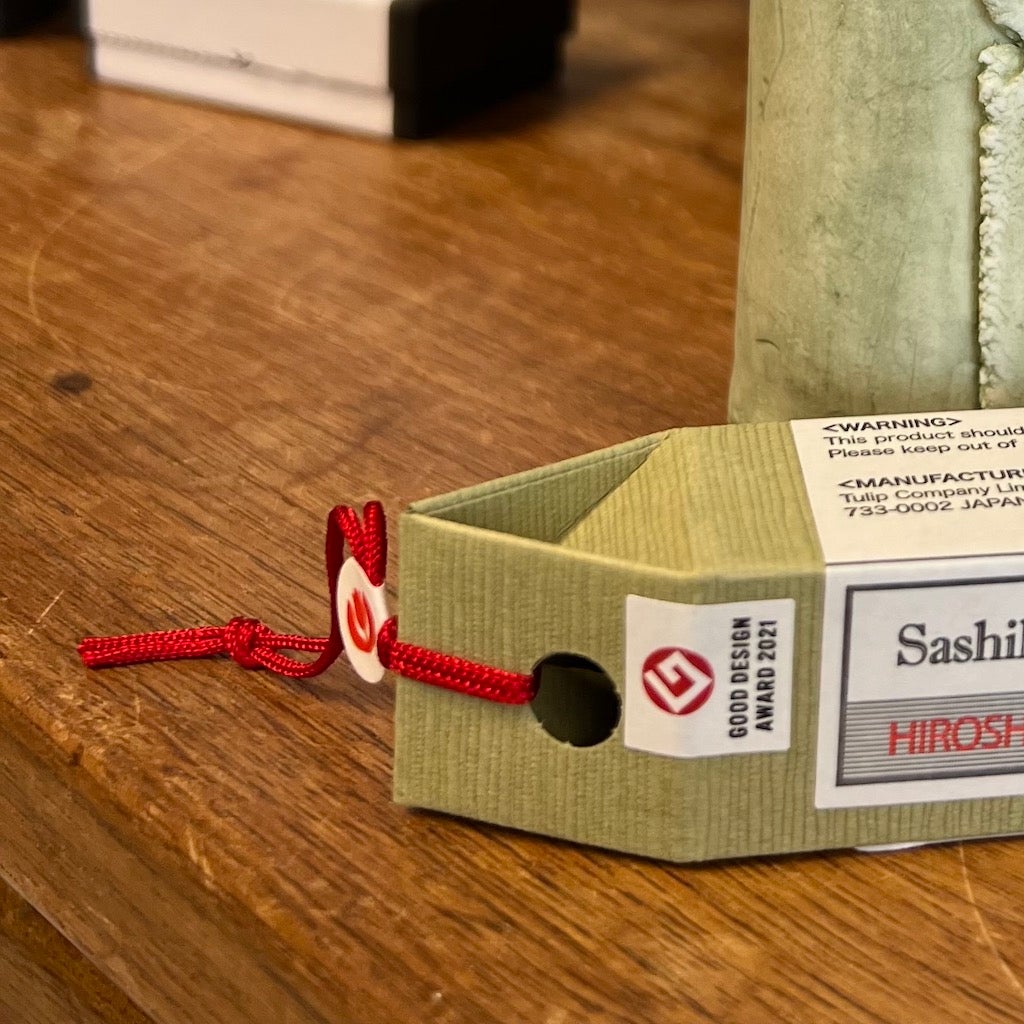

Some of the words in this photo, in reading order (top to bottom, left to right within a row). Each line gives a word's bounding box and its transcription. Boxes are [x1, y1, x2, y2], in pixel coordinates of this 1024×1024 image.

[822, 417, 962, 433] <WARNING>
[823, 435, 867, 447] This
[875, 431, 955, 445] product
[828, 445, 895, 459] Please
[901, 442, 951, 455] keep
[957, 440, 991, 452] out
[998, 438, 1019, 449] of
[839, 492, 889, 504] Tulip
[895, 484, 990, 500] Company
[844, 501, 953, 517] 733-0002
[731, 617, 751, 684] DESIGN
[757, 620, 778, 661] 2021
[755, 667, 776, 731] AWARD
[729, 689, 749, 738] GOOD
